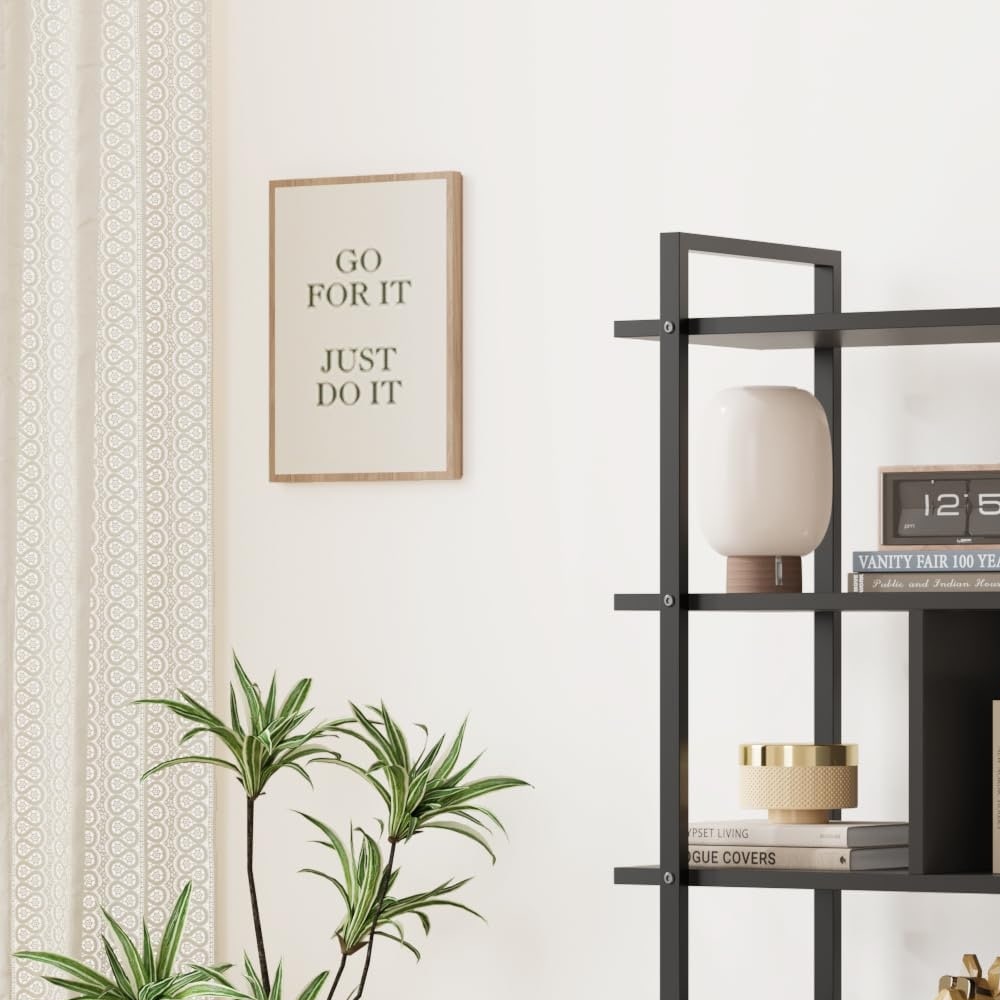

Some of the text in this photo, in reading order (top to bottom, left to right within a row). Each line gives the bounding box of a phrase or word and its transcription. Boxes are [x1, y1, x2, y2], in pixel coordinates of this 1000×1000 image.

[335, 248, 382, 274] GO
[306, 279, 412, 308] FOR IT
[320, 346, 398, 374] JUST
[316, 379, 403, 407] DO IT
[858, 554, 913, 569] VANITY
[917, 554, 949, 569] FAIR
[953, 554, 975, 569] 100
[872, 577, 904, 589] Public
[908, 579, 929, 589] and
[932, 578, 971, 589] Indian
[717, 828, 750, 839] LIVING
[722, 850, 776, 865] COVERS
